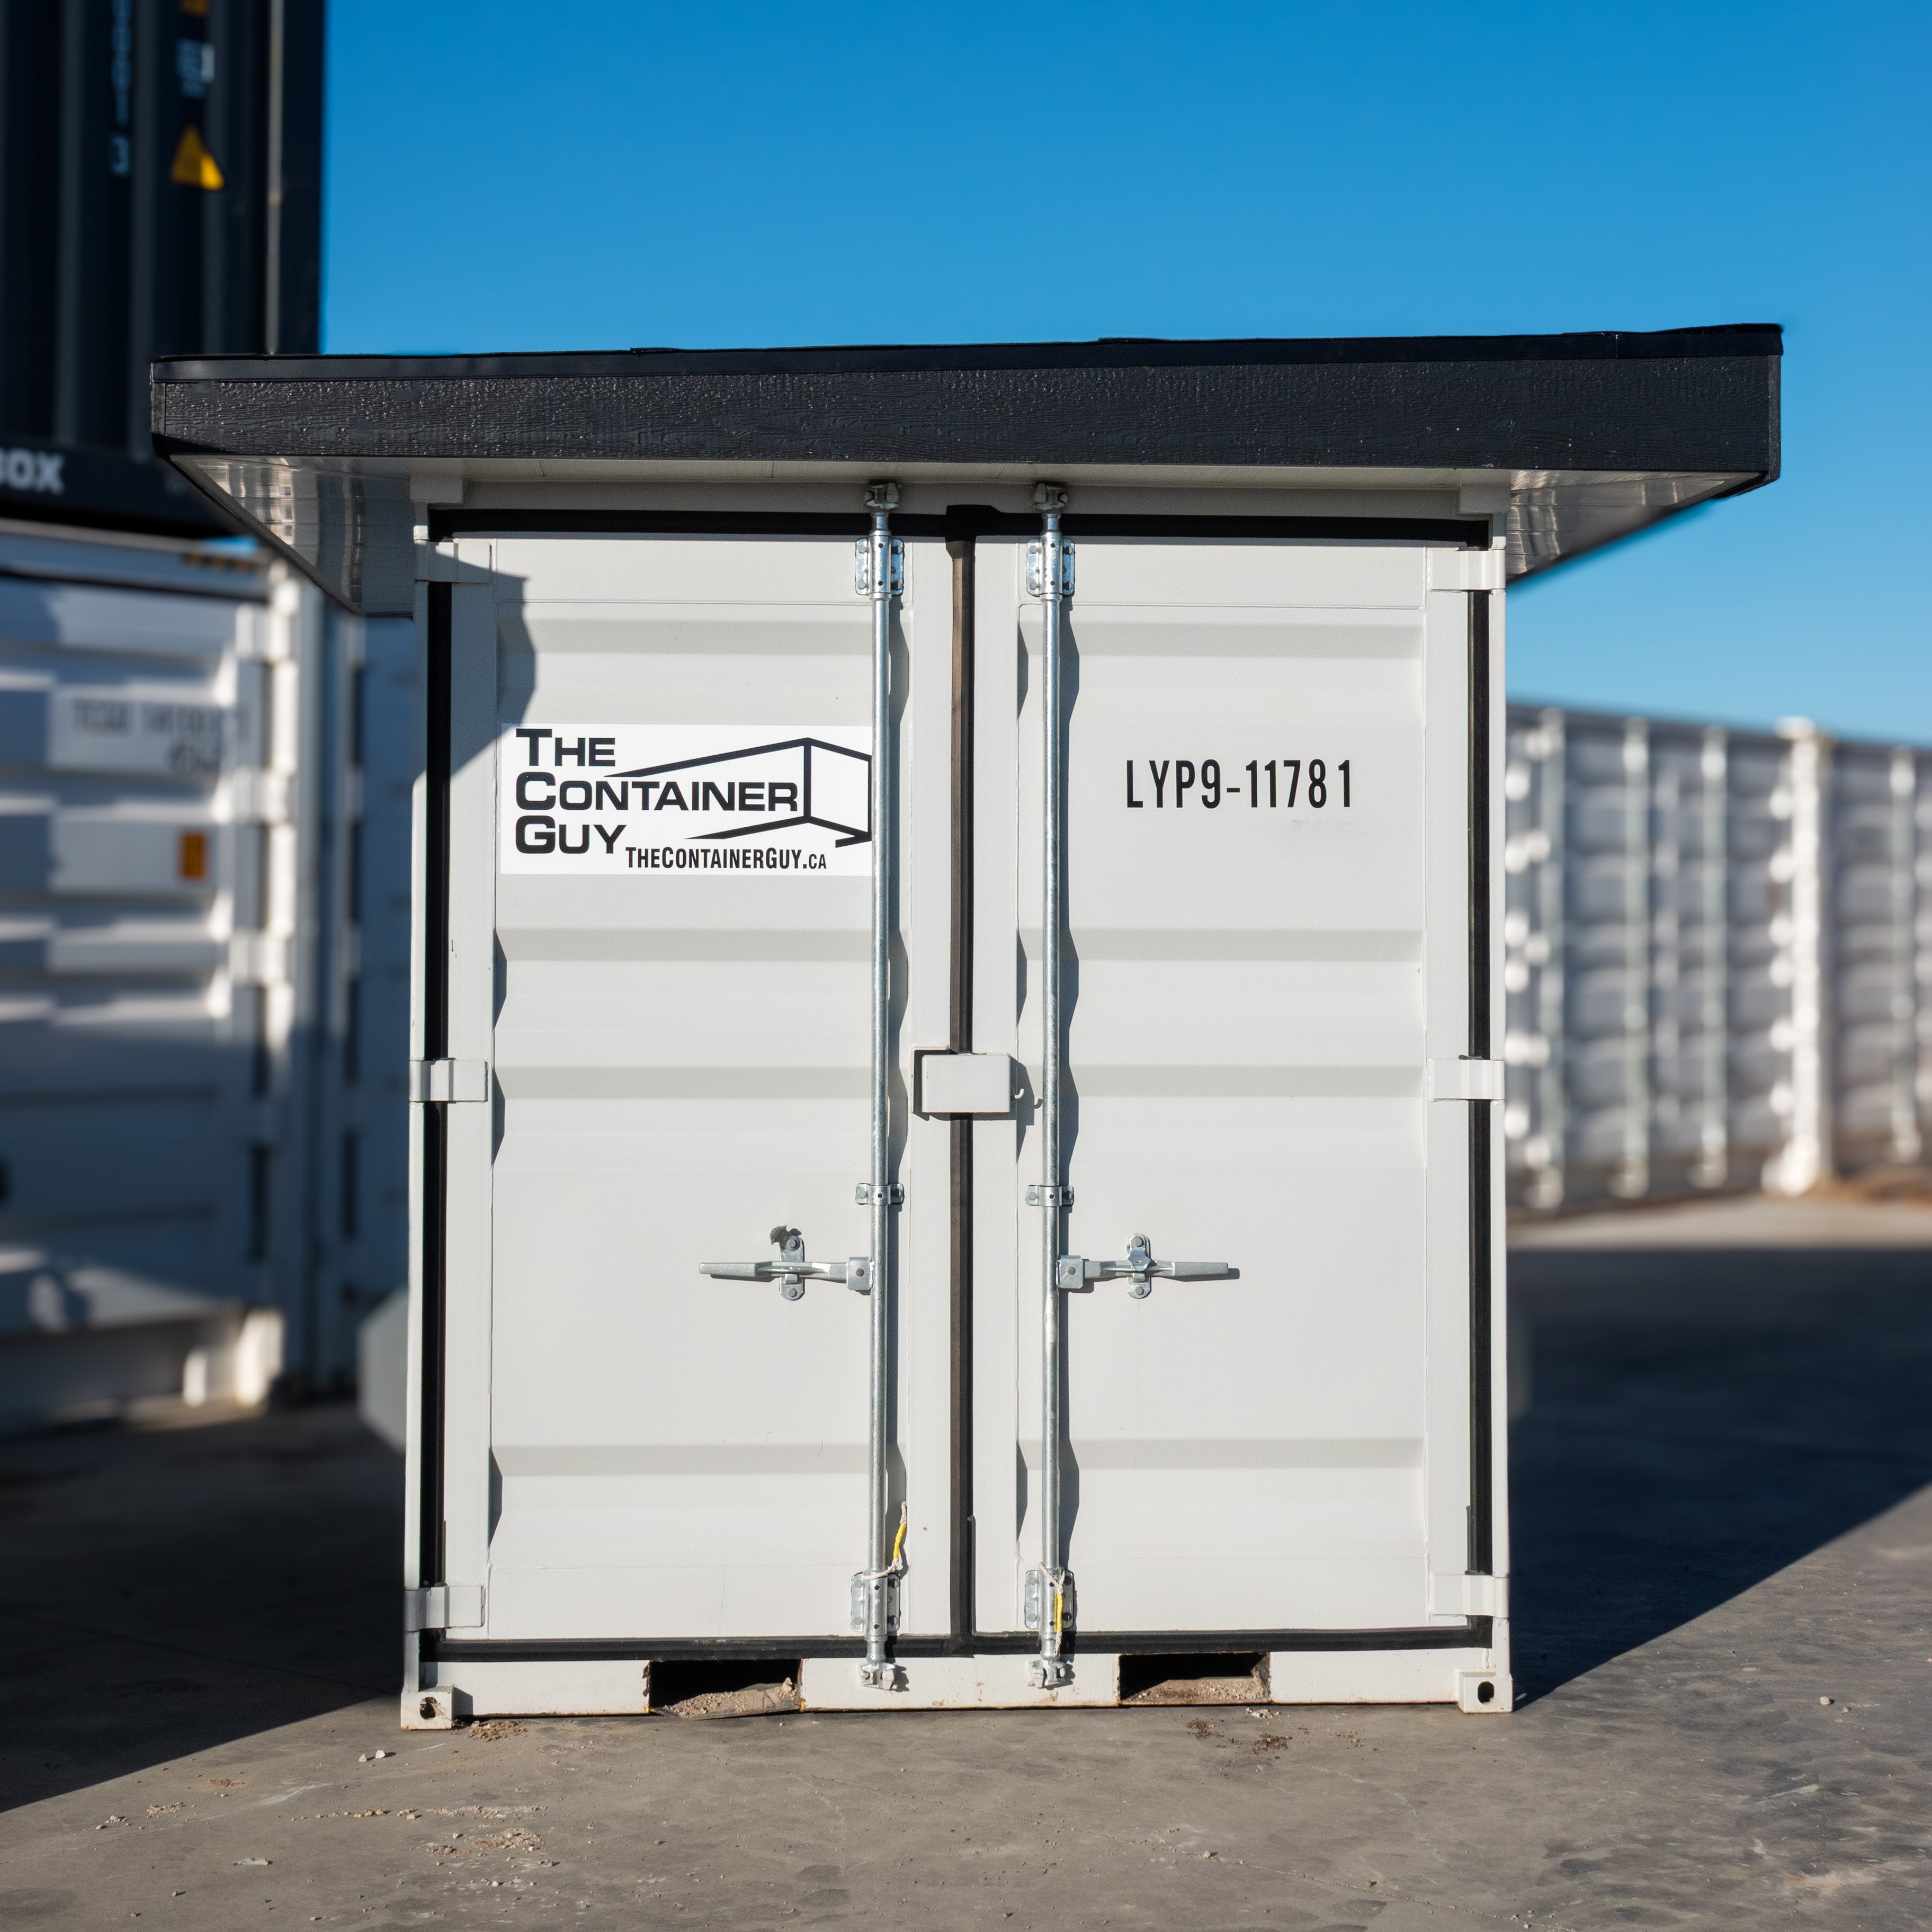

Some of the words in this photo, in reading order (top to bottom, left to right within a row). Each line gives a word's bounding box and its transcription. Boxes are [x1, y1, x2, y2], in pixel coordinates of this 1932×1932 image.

[0, 448, 65, 495] OX
[516, 728, 615, 766] THE
[516, 772, 798, 811] CONTAINER
[1126, 759, 1350, 809] LYP9-11781
[515, 815, 627, 854] GUY
